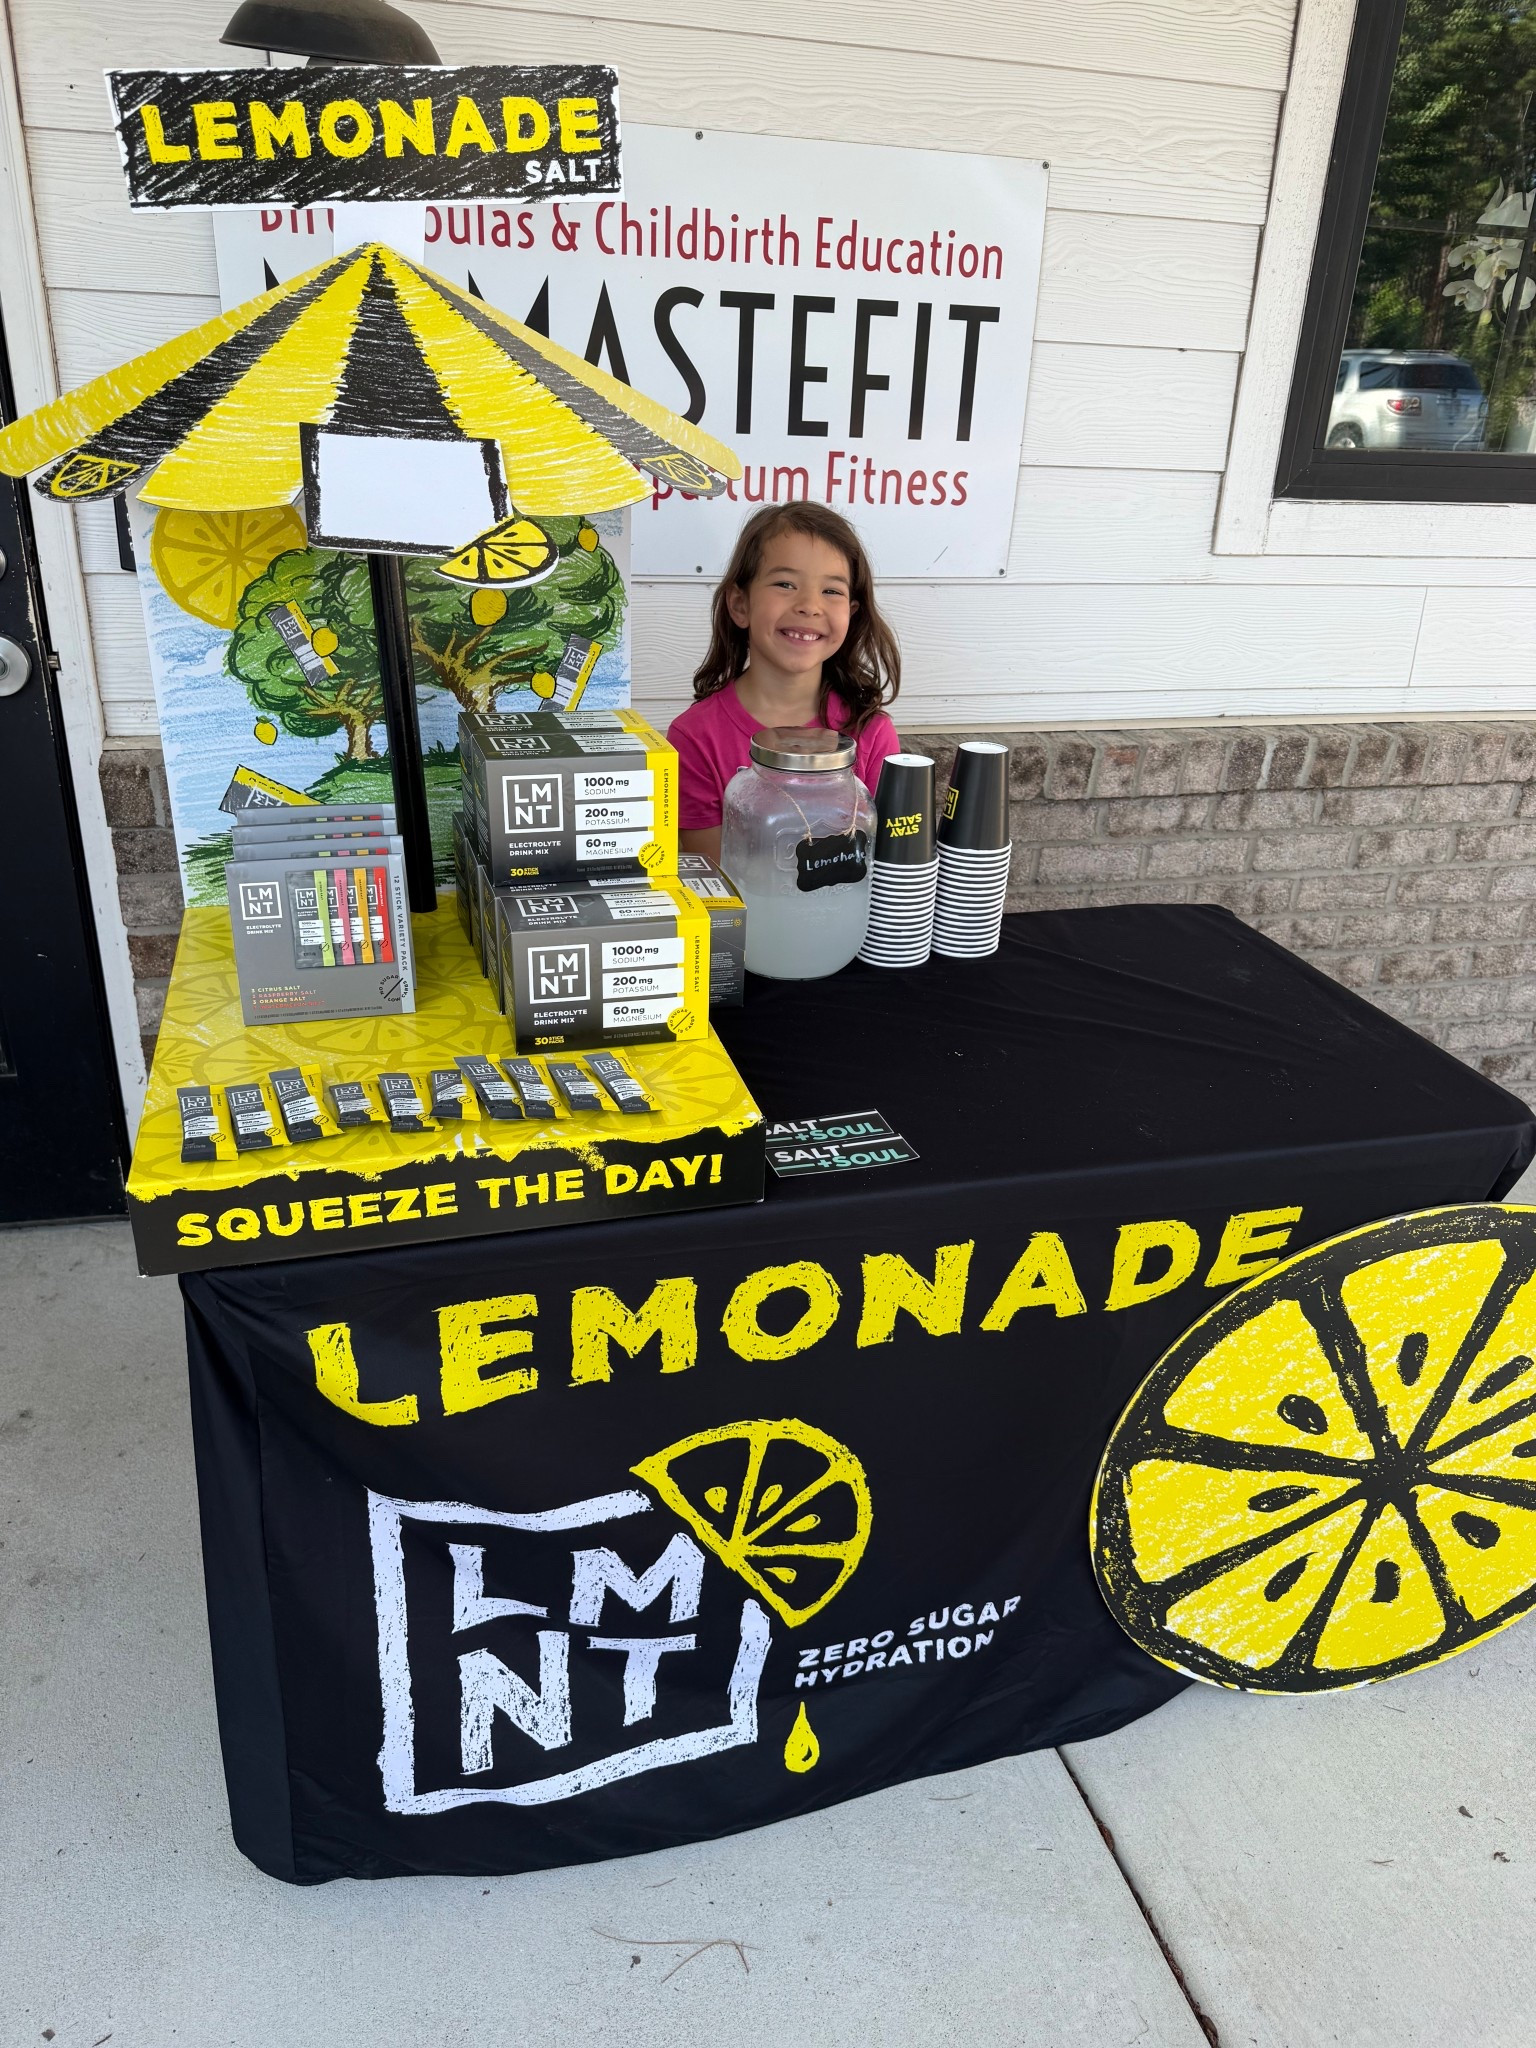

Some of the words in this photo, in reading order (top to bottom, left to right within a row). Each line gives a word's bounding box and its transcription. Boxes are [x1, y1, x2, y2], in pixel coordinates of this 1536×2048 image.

[140, 95, 602, 164] LEMONADE
[524, 158, 603, 185] SALT
[552, 203, 581, 252] &
[595, 202, 800, 266] Childbirth
[815, 216, 1003, 280] Education
[825, 450, 969, 507] Fitness
[584, 777, 614, 787] 1000
[615, 779, 630, 787] mg
[513, 782, 552, 804] LM
[584, 788, 616, 796] SODIUM
[515, 804, 553, 826] NT
[585, 808, 609, 818] 200
[610, 810, 624, 818] mg
[585, 817, 630, 826] POTASSIUM
[885, 812, 923, 829] SALTY
[889, 824, 920, 838] STAY
[509, 840, 562, 849] ELECTROLYTE
[585, 838, 602, 848] 60
[602, 840, 617, 848] mg
[509, 849, 533, 857] DRINK
[585, 847, 634, 856] MAGNESIUM
[393, 875, 399, 884] 12
[510, 868, 524, 877] 30
[247, 887, 273, 901] LM
[394, 886, 403, 910] STICK
[249, 901, 274, 915] NT
[397, 913, 406, 948] VARIETY
[612, 945, 643, 956] 1000
[400, 950, 408, 971] PACK
[539, 952, 578, 974] LM
[612, 956, 645, 965] SODIUM
[540, 974, 579, 996] NT
[612, 976, 637, 986] 200
[638, 977, 653, 985] mg
[612, 985, 659, 994] POTASSIUM
[533, 1008, 588, 1019] ELECTROLYTE
[613, 1006, 629, 1015] 60
[630, 1007, 645, 1015] mg
[533, 1018, 559, 1026] DRINK
[613, 1013, 662, 1023] MAGNESIUM
[534, 1036, 549, 1046] 30
[774, 1145, 840, 1163] SALT
[176, 1182, 459, 1246] SQUEEZE
[478, 1168, 585, 1208] THE
[604, 1153, 722, 1194] DAY!
[308, 1206, 1304, 1427] LEMONADE
[446, 1531, 707, 1634] LM
[798, 1629, 895, 1668] ZERO
[906, 1595, 1022, 1636] SUGAR
[794, 1628, 995, 1688] HYDRATION
[456, 1629, 701, 1776] NT
